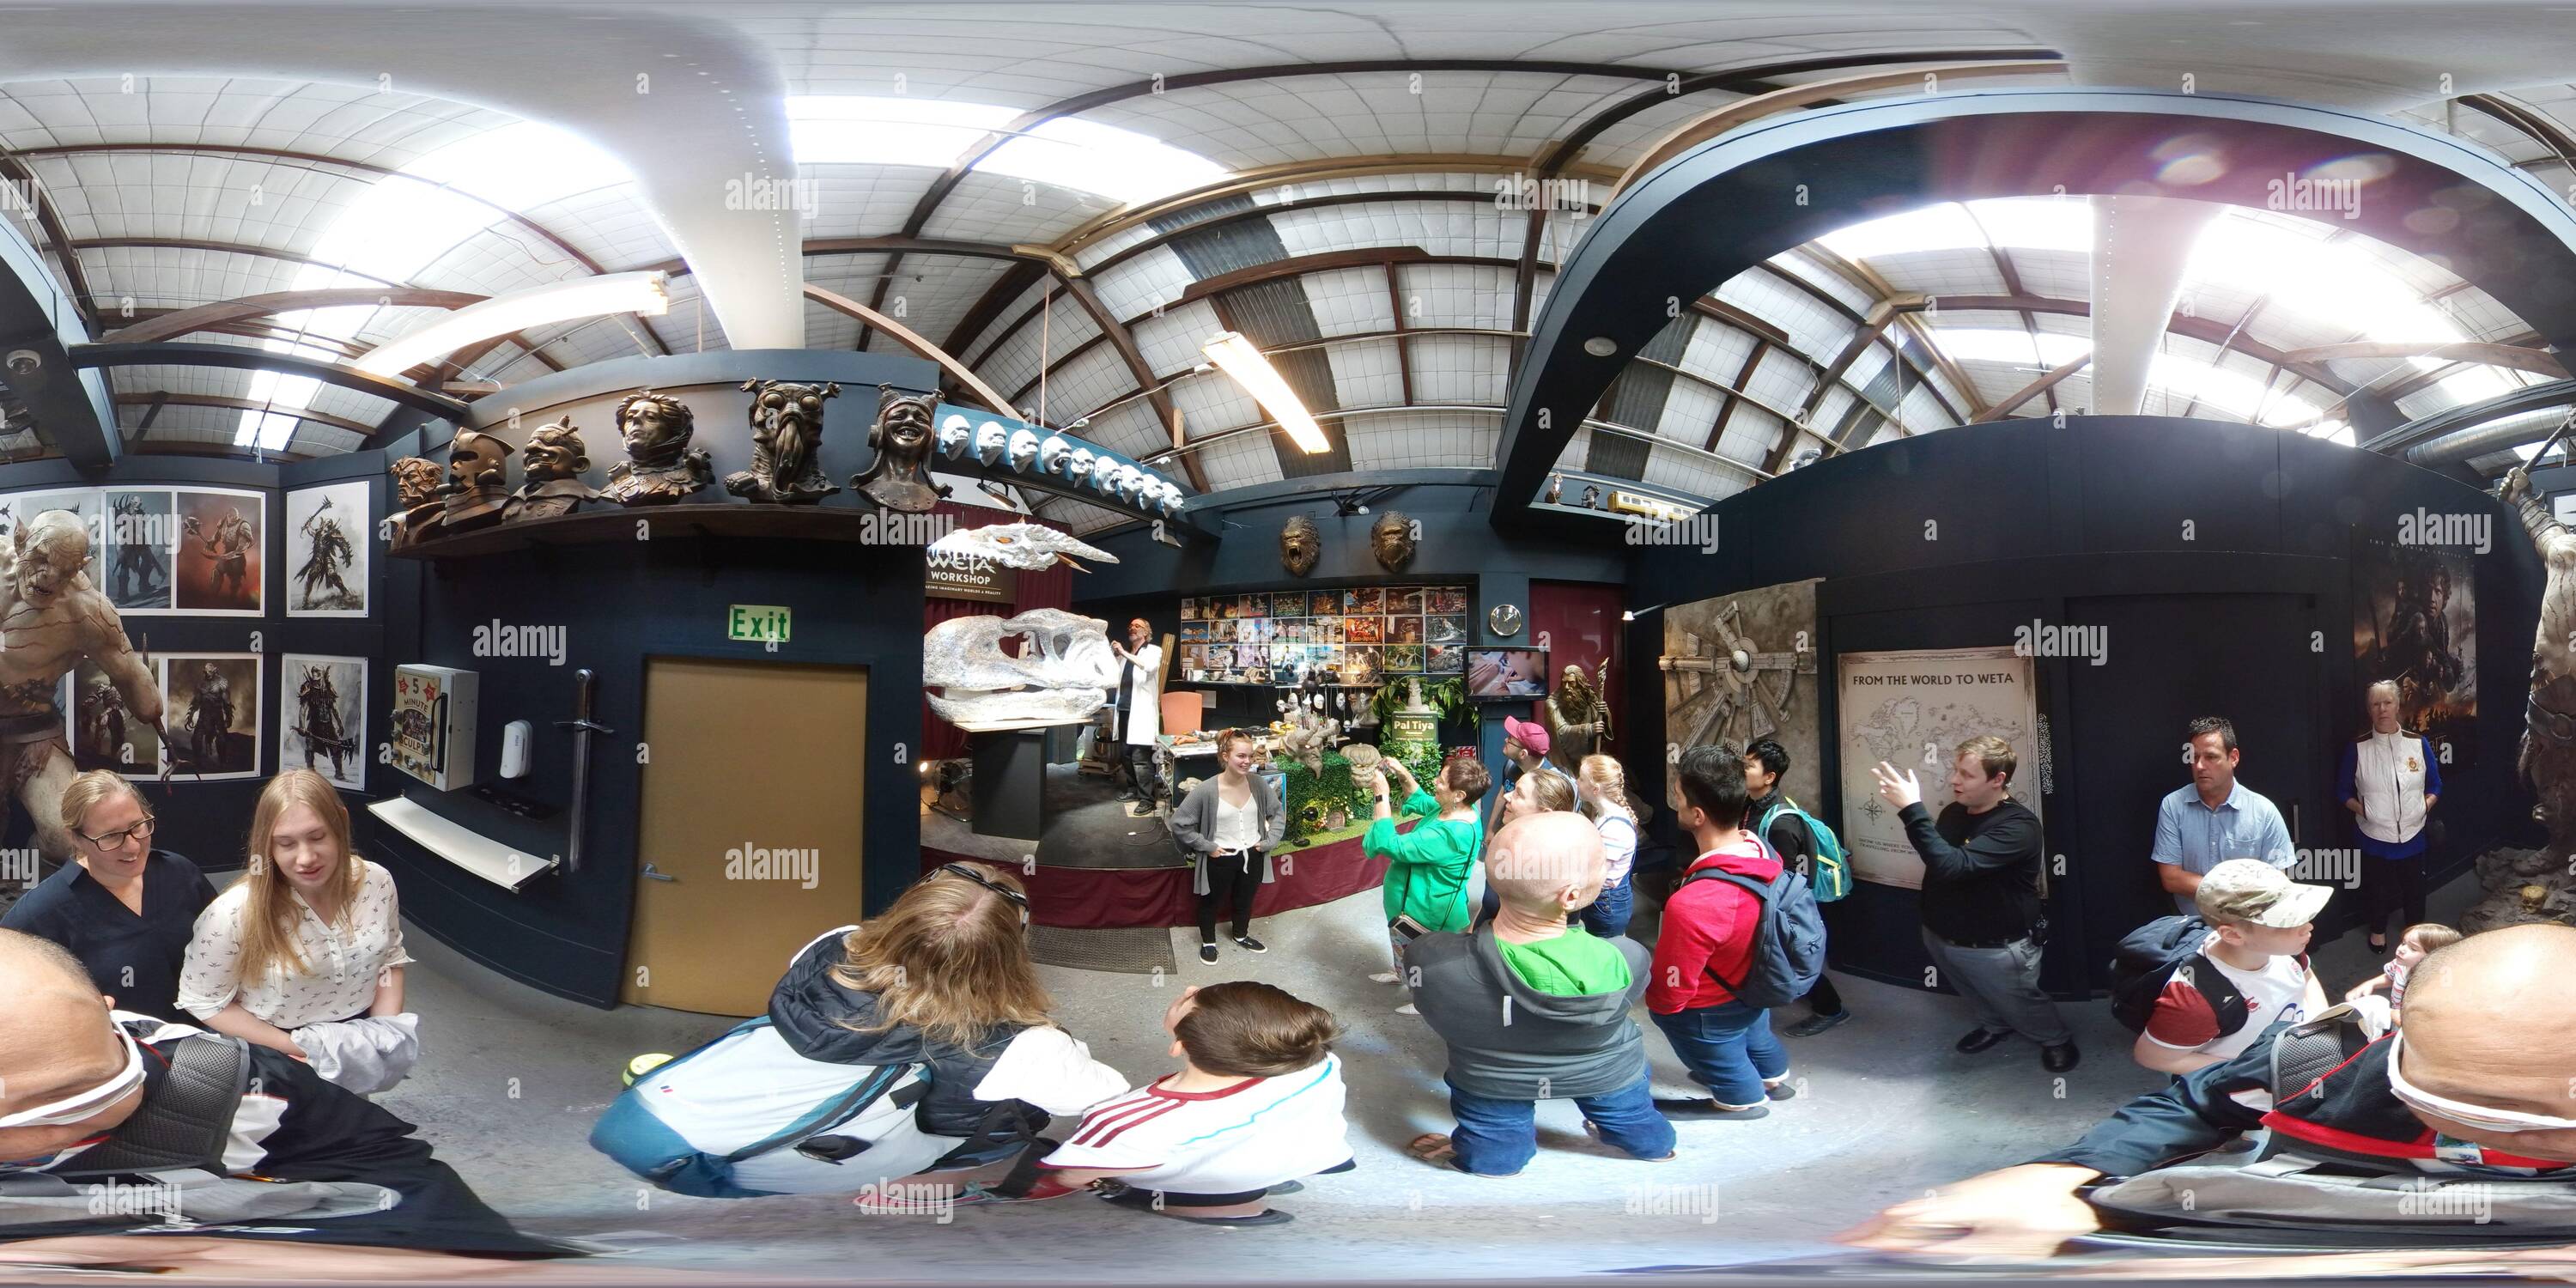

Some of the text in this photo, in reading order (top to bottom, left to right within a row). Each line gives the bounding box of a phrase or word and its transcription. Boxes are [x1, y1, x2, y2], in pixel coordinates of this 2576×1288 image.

[931, 571, 991, 585] WORKSHOP
[732, 609, 787, 638] Exit
[1853, 673, 2014, 685] FROM THE WORLD TO WETA
[412, 678, 420, 695] 5
[404, 698, 428, 712] MINUTE
[1394, 720, 1434, 732] Pal Tiya
